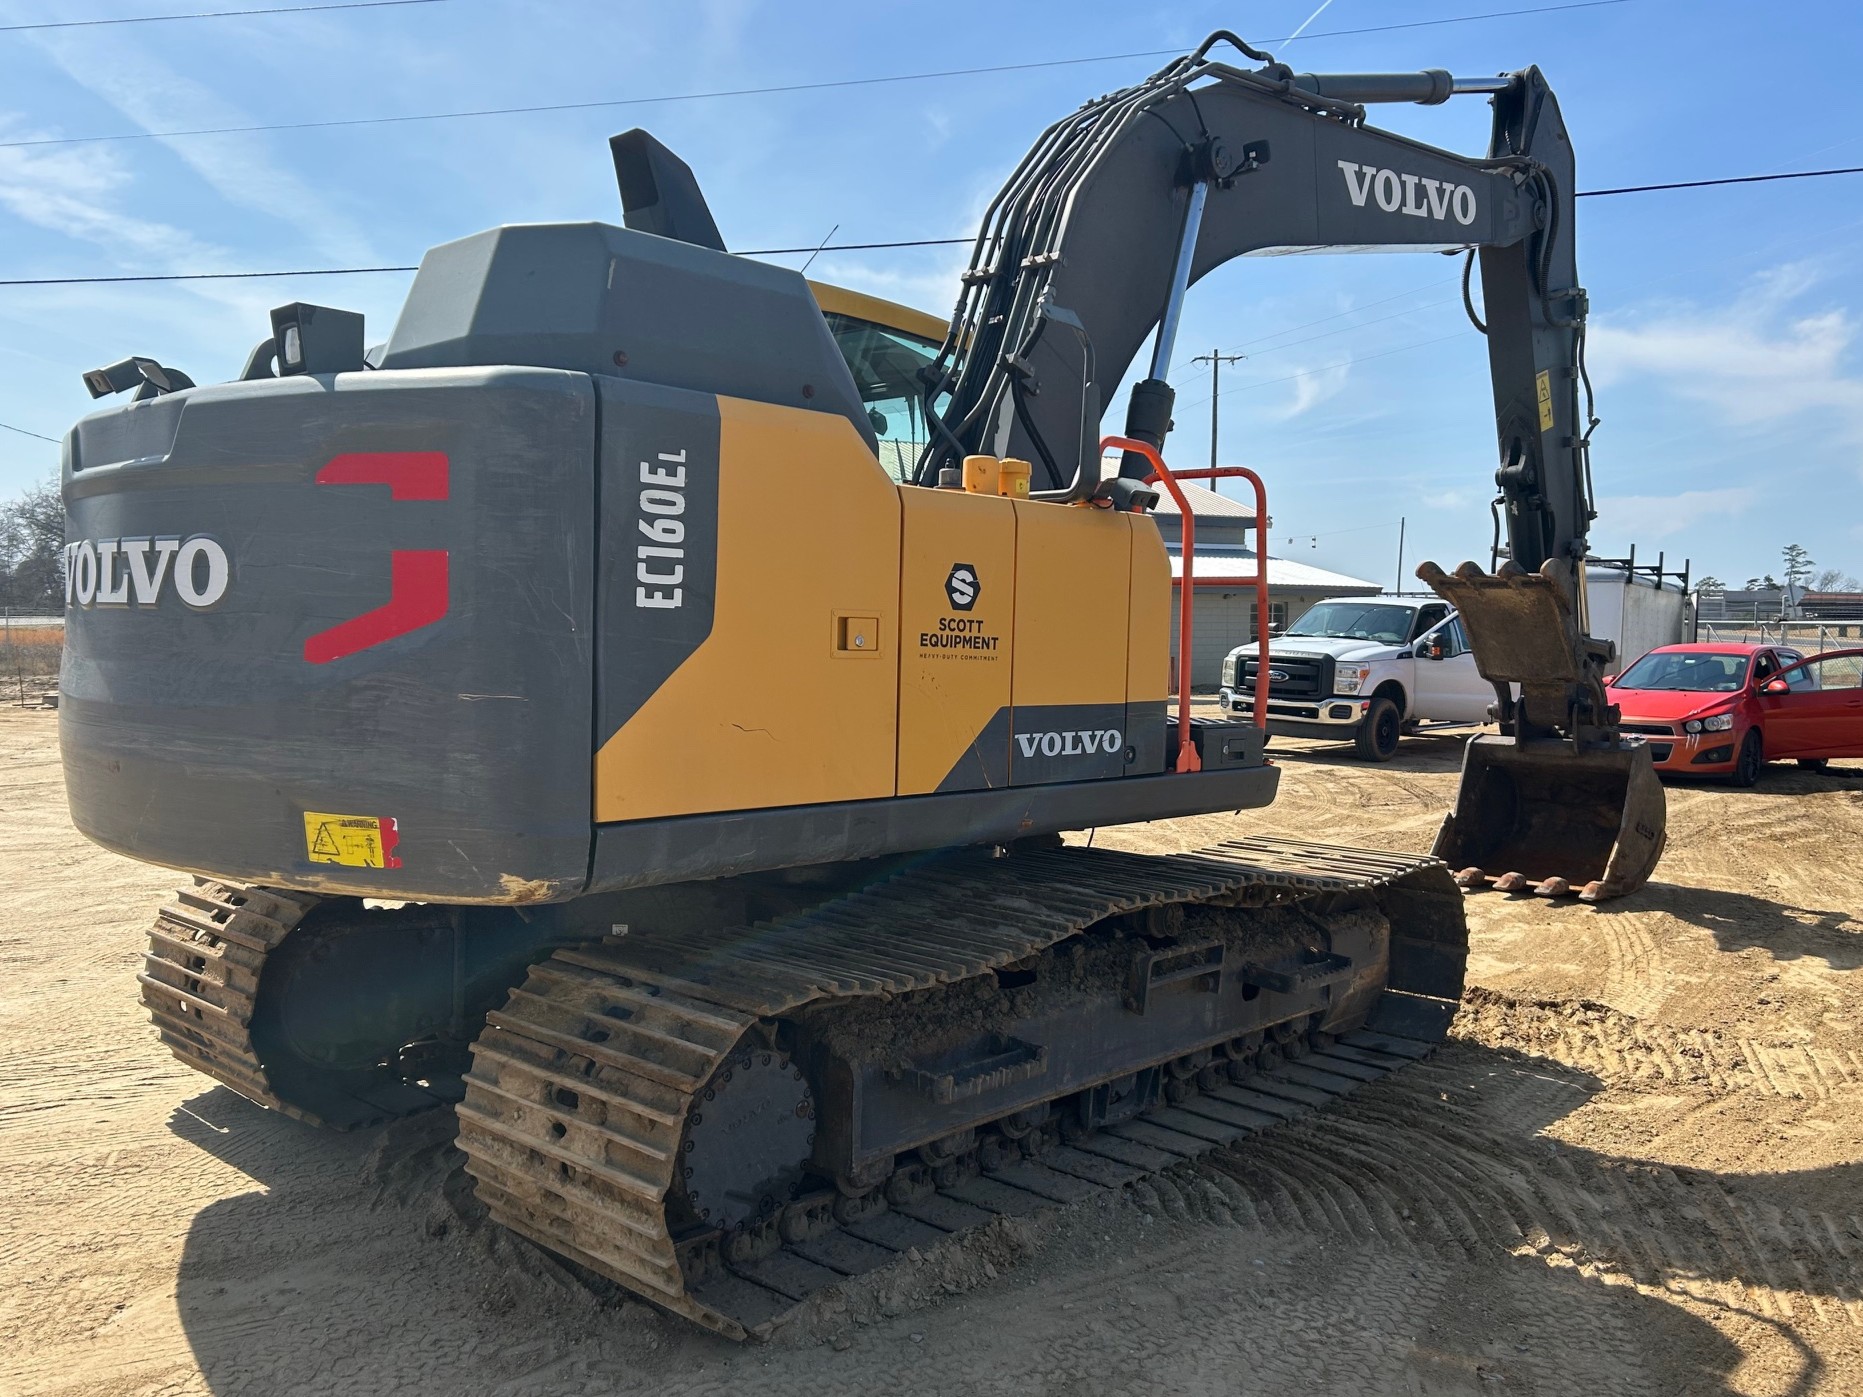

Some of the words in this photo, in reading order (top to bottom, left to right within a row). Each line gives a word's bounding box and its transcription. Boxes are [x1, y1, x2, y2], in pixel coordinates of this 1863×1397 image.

[1337, 159, 1477, 226] VOLVO
[63, 537, 229, 607] VOLVO
[939, 617, 984, 633] SCOTT
[920, 632, 999, 650] EQUIPMENT
[960, 654, 998, 662] COMMITMENT
[1014, 729, 1122, 758] VOLVO
[347, 819, 378, 829] WARNING
